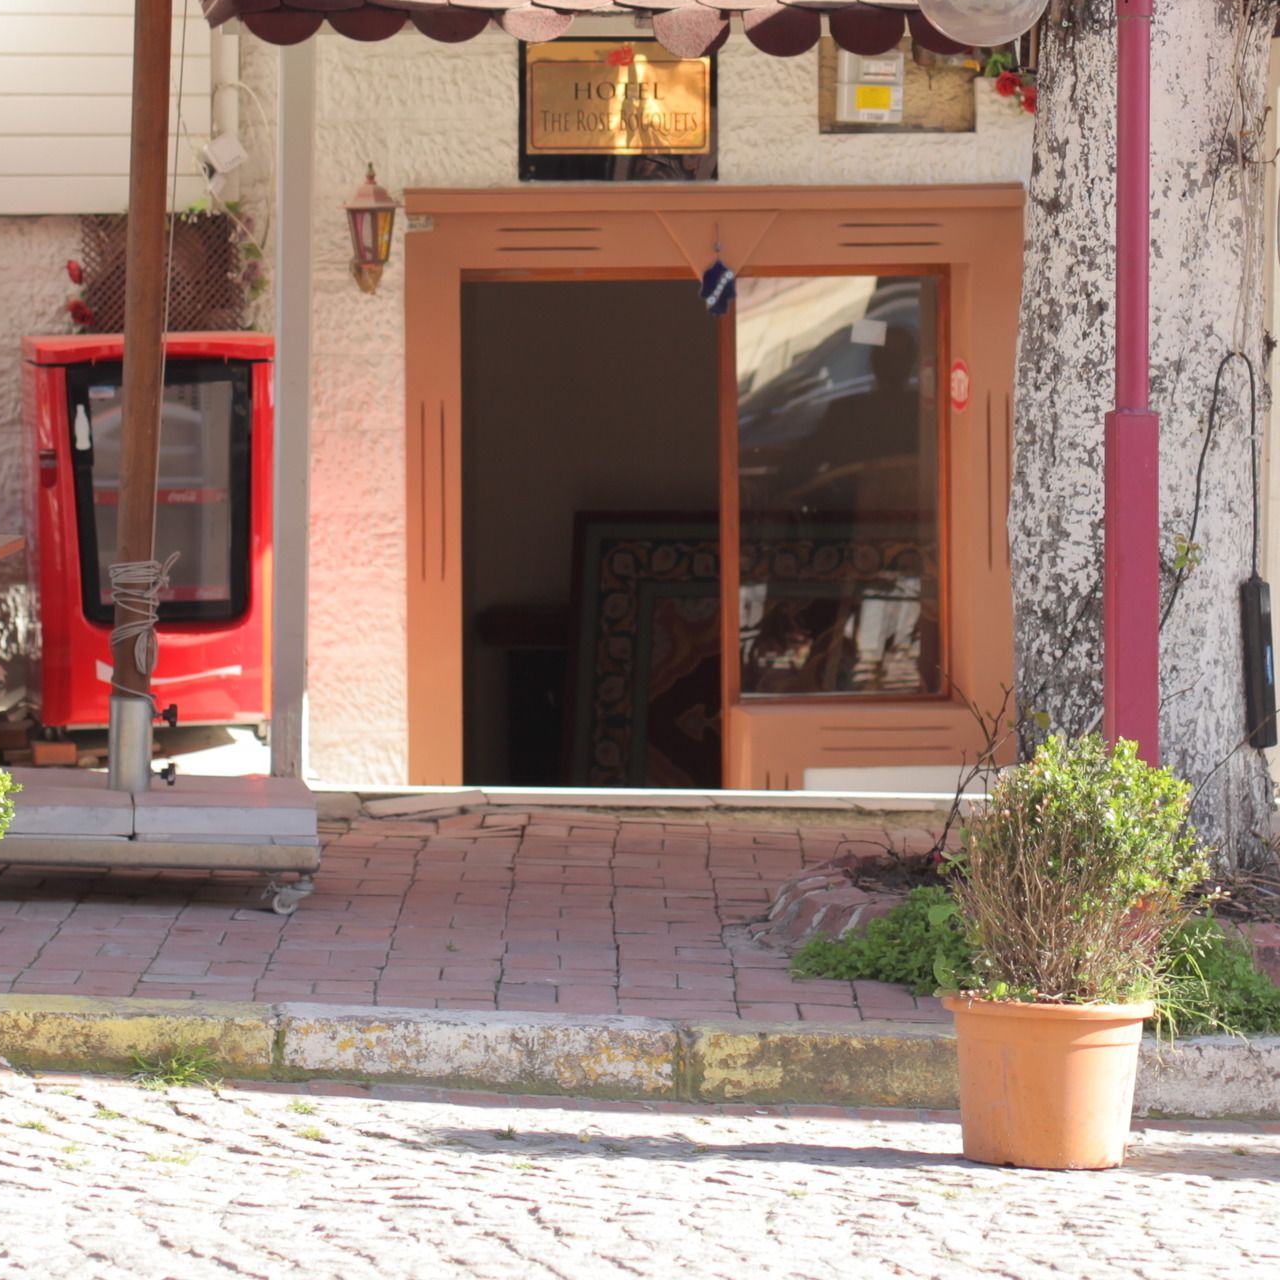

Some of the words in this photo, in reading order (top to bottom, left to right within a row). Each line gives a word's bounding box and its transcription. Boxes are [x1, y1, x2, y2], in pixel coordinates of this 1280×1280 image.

[574, 81, 665, 100] HOTEL
[541, 110, 570, 133] THE
[576, 110, 613, 132] ROSE
[620, 111, 698, 136] BOUQUETS
